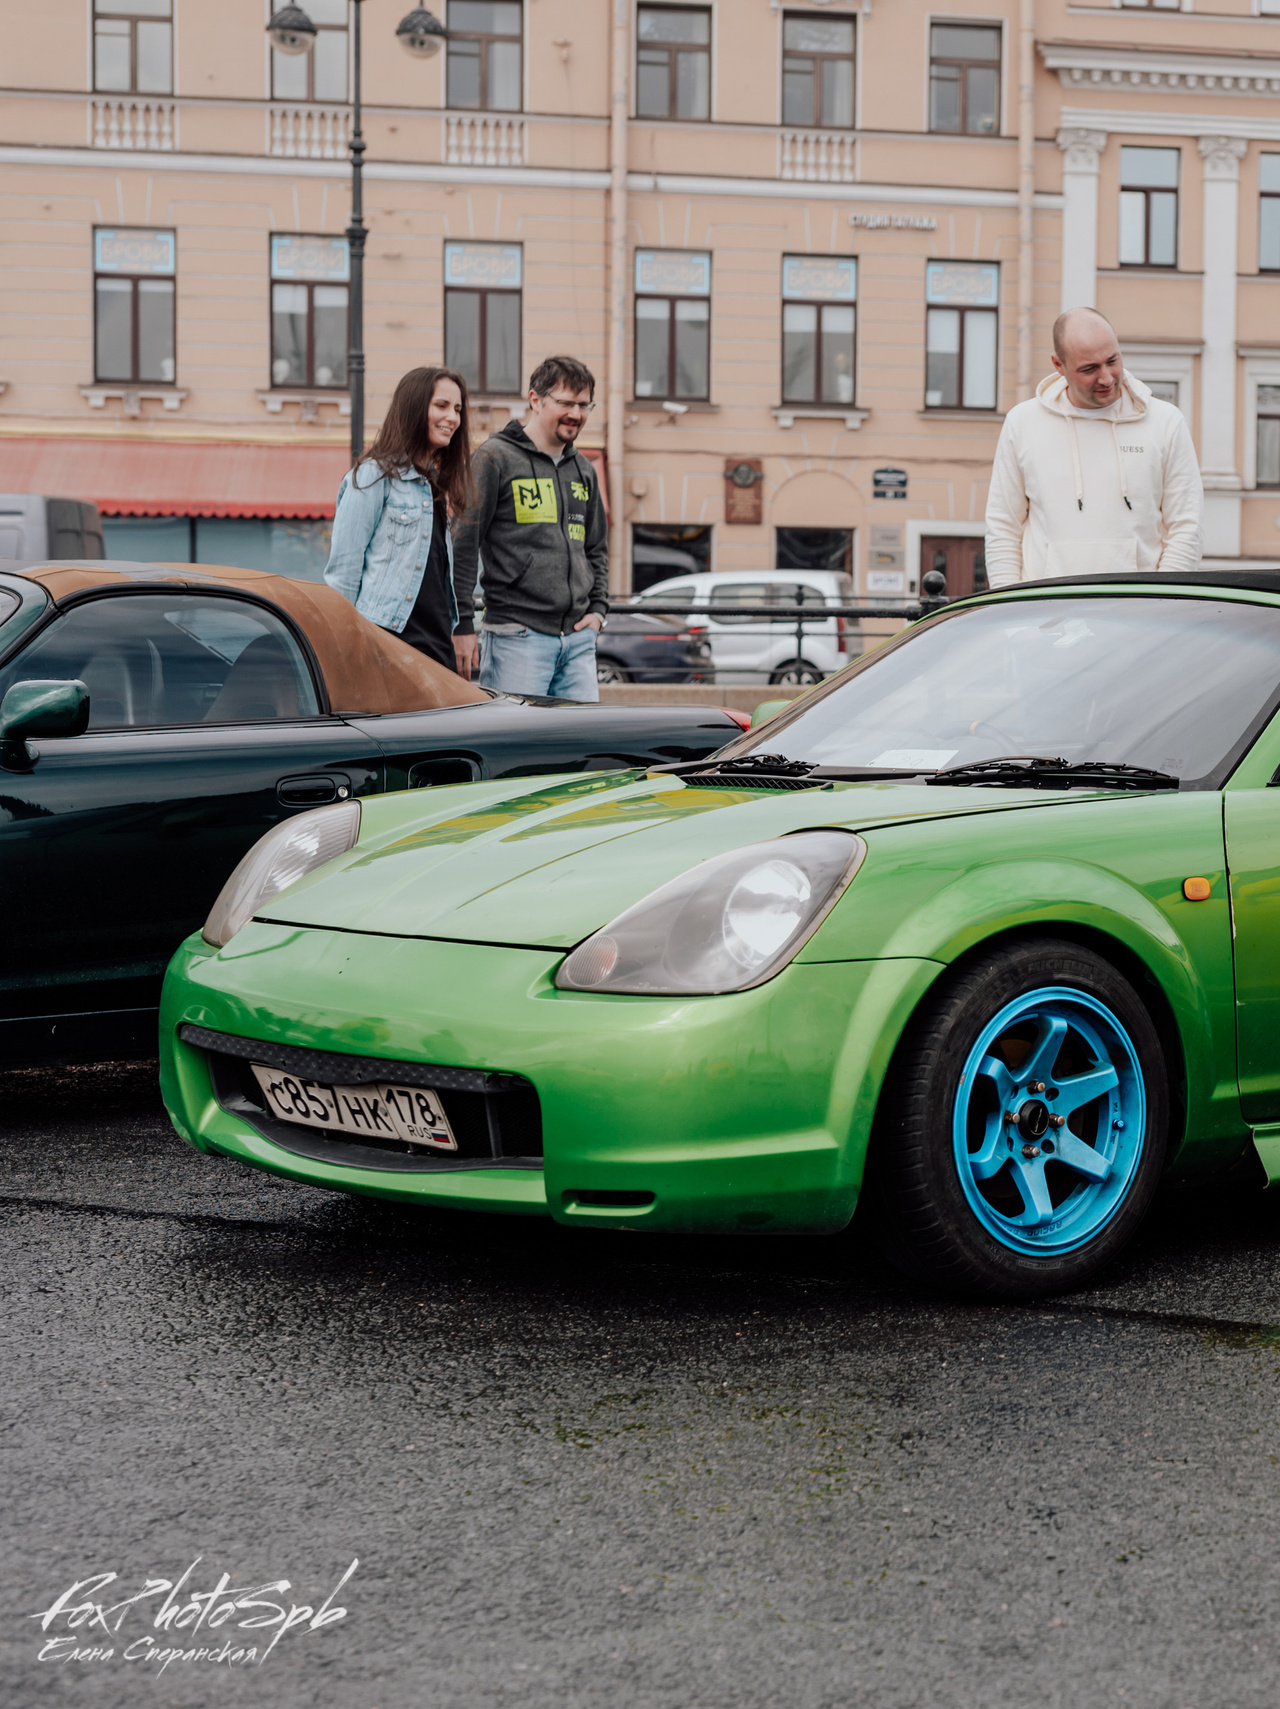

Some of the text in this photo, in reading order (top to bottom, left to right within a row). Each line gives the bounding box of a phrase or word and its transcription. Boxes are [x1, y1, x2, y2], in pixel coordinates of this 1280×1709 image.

[789, 269, 850, 288] БРОВИ
[932, 272, 991, 293] БРОВИ
[385, 1089, 436, 1127] 178
[407, 1125, 432, 1139] RUS
